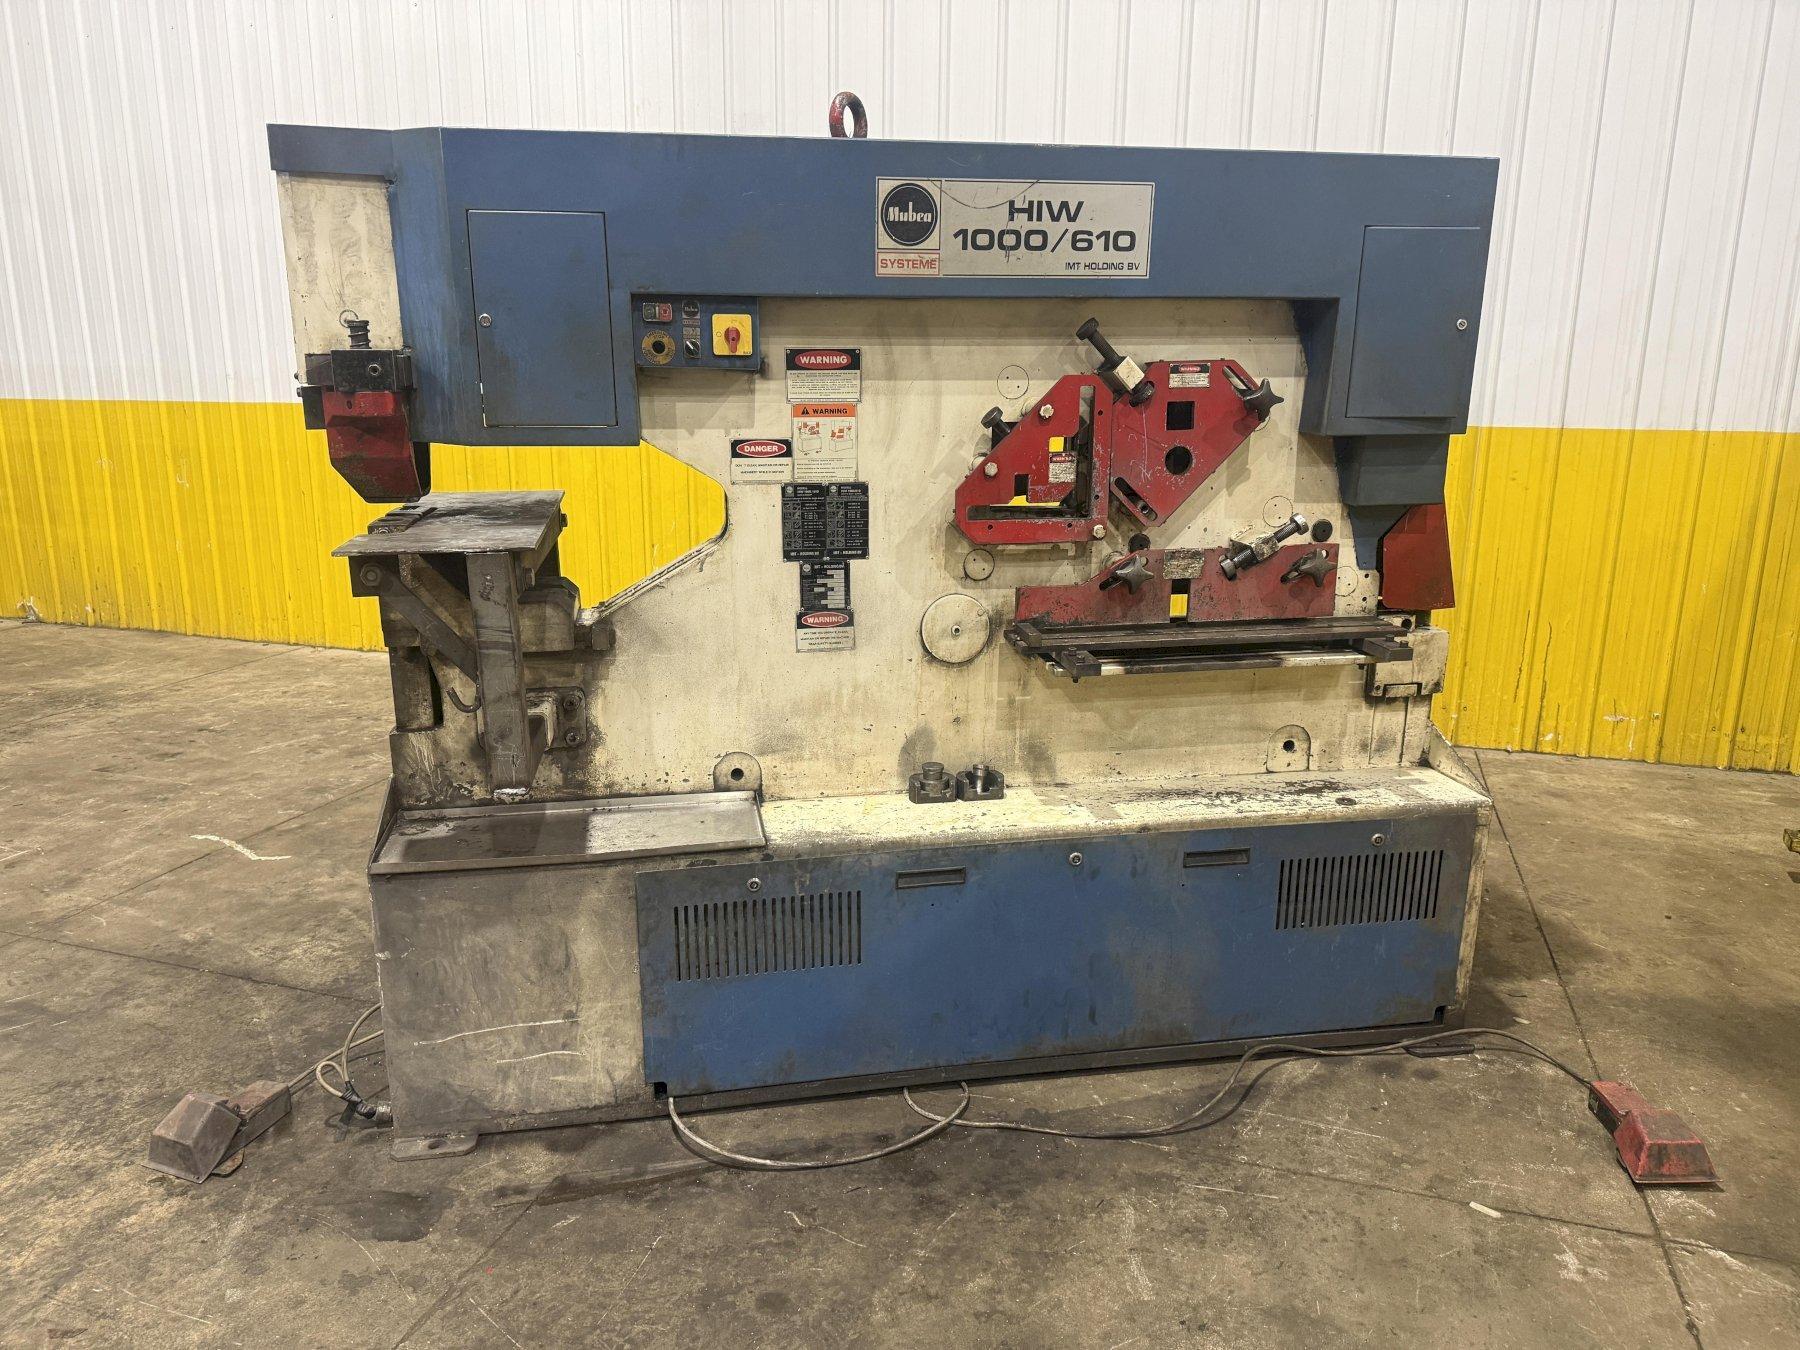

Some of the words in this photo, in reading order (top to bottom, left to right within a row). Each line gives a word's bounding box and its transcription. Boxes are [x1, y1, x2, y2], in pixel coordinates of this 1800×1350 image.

[887, 202, 932, 223] Mubea
[1008, 199, 1085, 223] HIW
[953, 228, 1137, 253] 1000/610
[880, 257, 938, 270] SYSTEME
[1065, 262, 1081, 271] IMT
[1084, 262, 1125, 271] HOLDING
[1127, 262, 1141, 271] BV
[799, 355, 848, 364] WARNING
[807, 616, 844, 624] WARNING
